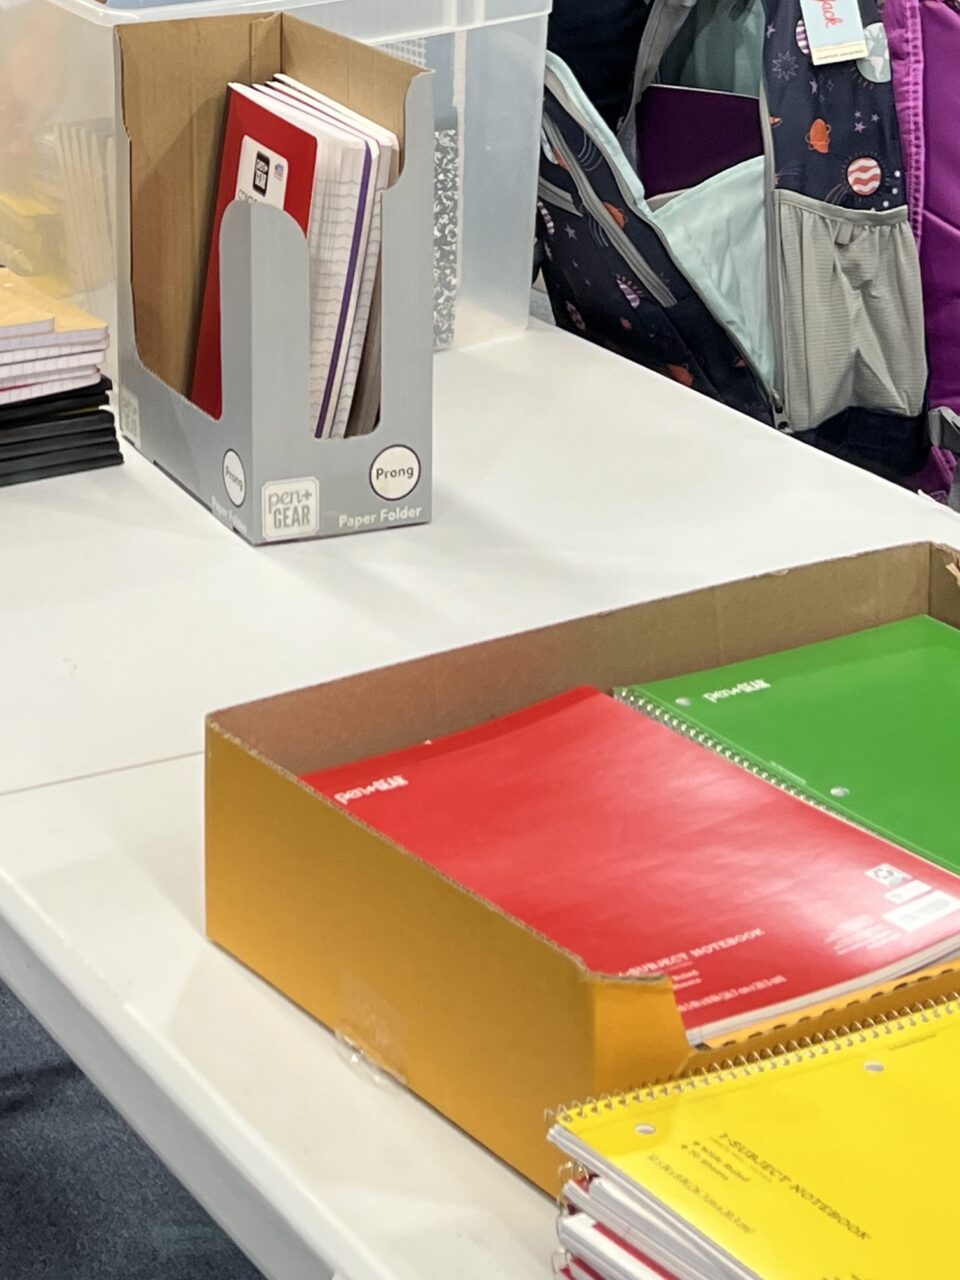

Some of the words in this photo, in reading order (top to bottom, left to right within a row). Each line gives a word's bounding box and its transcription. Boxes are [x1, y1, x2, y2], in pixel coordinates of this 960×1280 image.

[374, 465, 415, 482] Prong
[273, 507, 311, 530] GEAR
[338, 511, 377, 529] Paper
[379, 504, 423, 523] Folder
[689, 927, 766, 959] NOTEBOOK
[789, 1183, 873, 1241] NOTEBOOK
